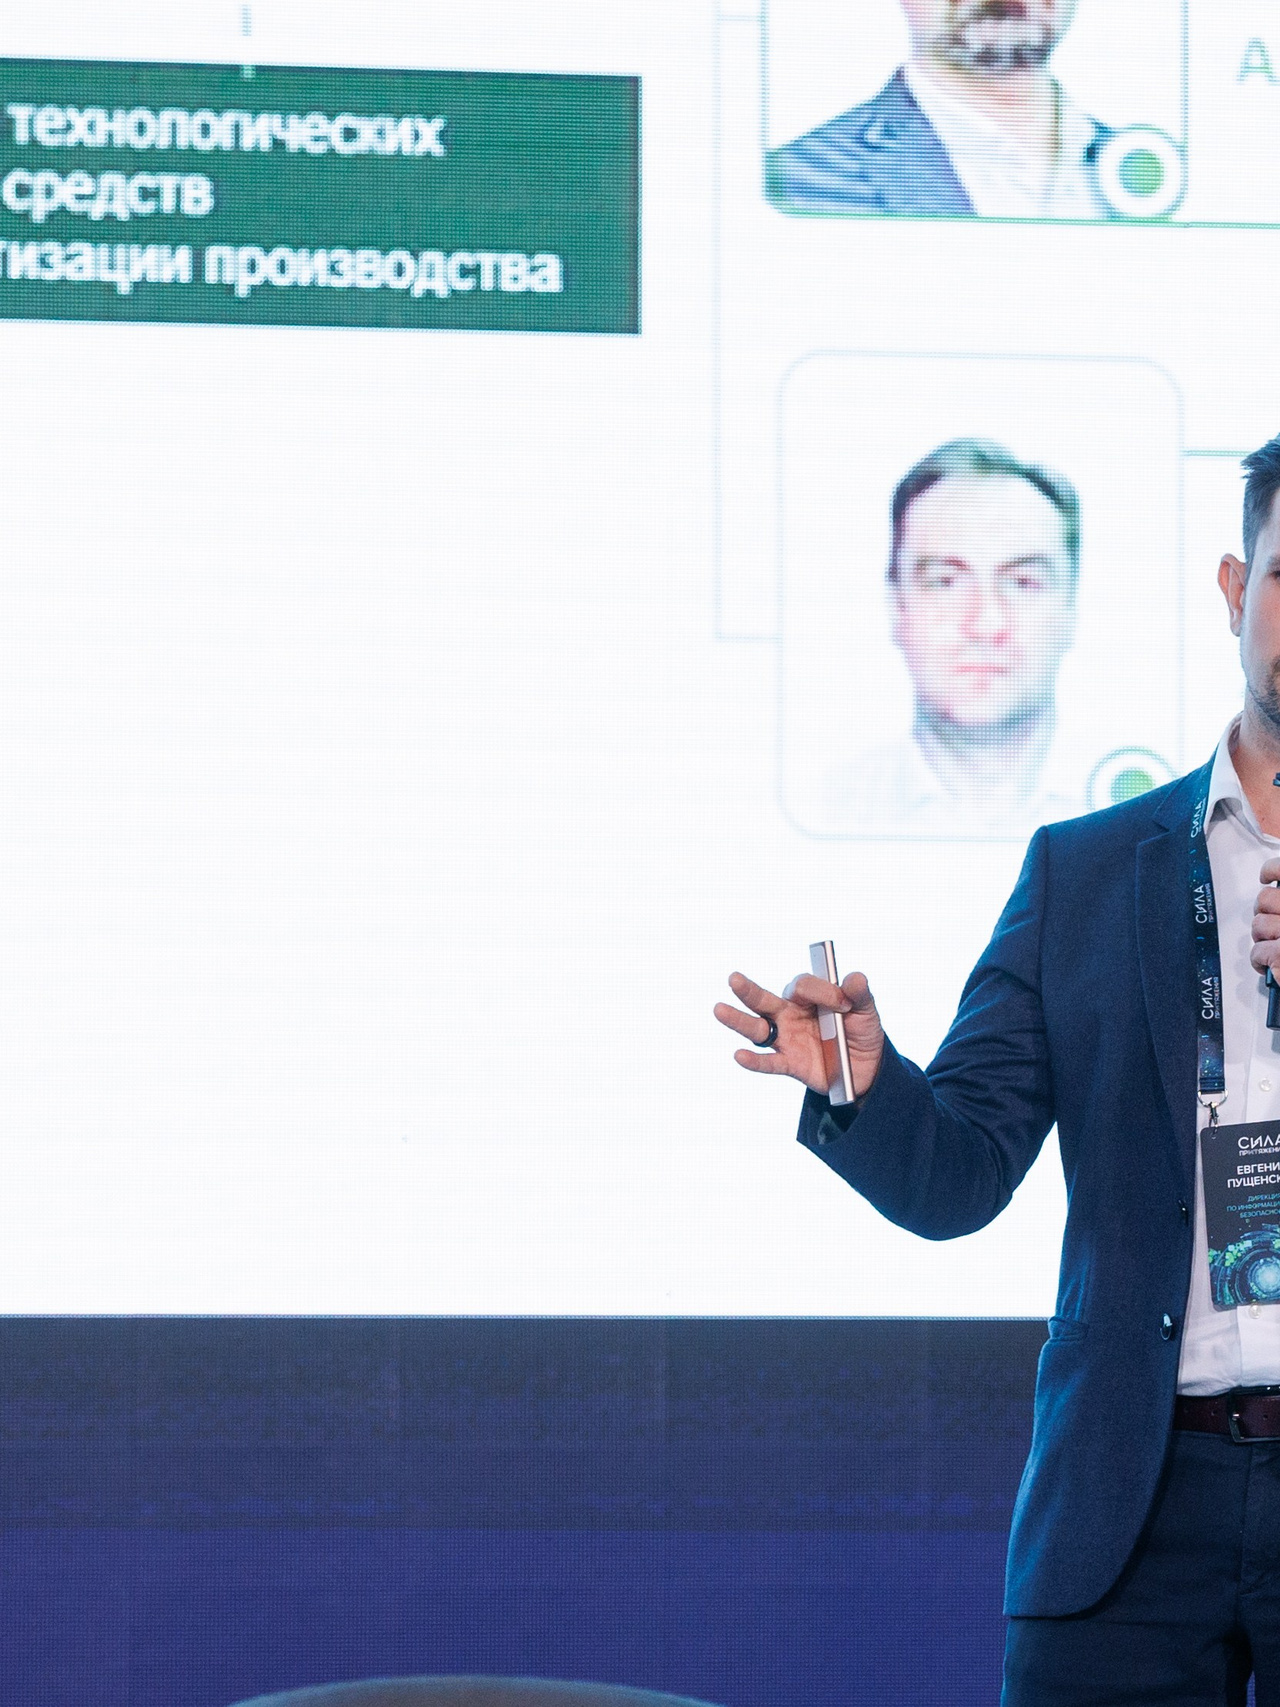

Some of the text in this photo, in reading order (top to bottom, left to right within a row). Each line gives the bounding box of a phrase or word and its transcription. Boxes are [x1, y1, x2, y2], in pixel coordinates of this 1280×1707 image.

[6, 102, 449, 157] технологических
[0, 166, 215, 223] средств
[204, 243, 564, 298] производства
[1190, 800, 1203, 838] СИЛА
[1193, 884, 1208, 924] СИЛА
[1201, 976, 1214, 1020] СИЛА
[1226, 1205, 1238, 1213] ПО
